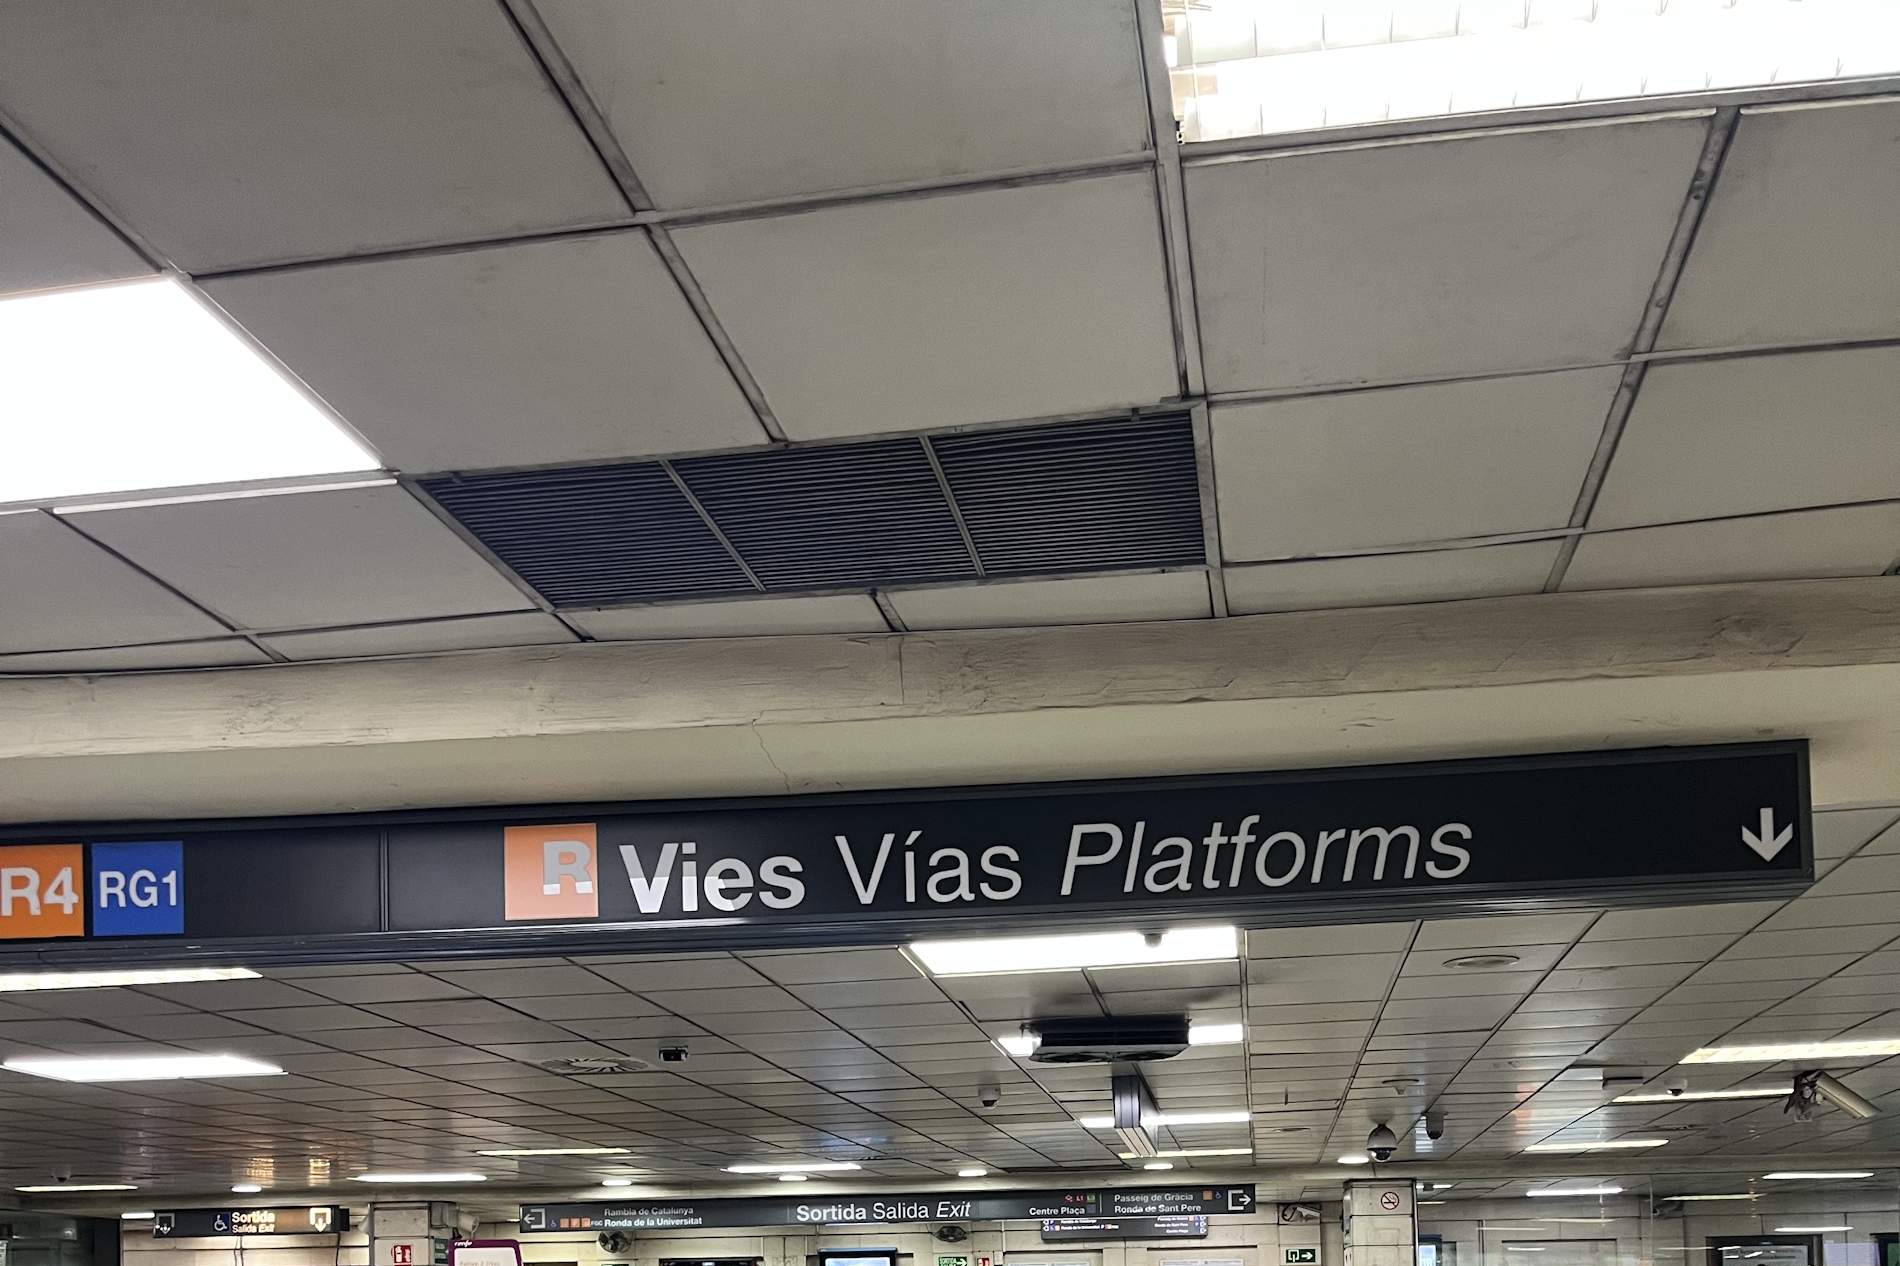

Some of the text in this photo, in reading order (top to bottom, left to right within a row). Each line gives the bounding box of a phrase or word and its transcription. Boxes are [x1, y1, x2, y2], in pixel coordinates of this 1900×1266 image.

[542, 814, 1473, 914] R Vies Vías Platforms
[0, 866, 79, 917] R4
[100, 868, 179, 908] RG1
[1114, 1193, 1194, 1203] Passeig de Gràcia
[604, 1206, 694, 1216] Rambla de Catalunya
[796, 1201, 971, 1221] Sortida Salida Exit
[1029, 1206, 1085, 1216] Centre Plaça
[1114, 1205, 1144, 1213] Ronda
[1158, 1204, 1180, 1212] Sant
[1181, 1203, 1202, 1212] Pere
[232, 1211, 276, 1223] Sortida
[604, 1218, 633, 1227] Ronda
[634, 1218, 645, 1226] de
[647, 1218, 655, 1226] la
[656, 1217, 703, 1226] Universitat
[454, 1240, 473, 1248] renfe
